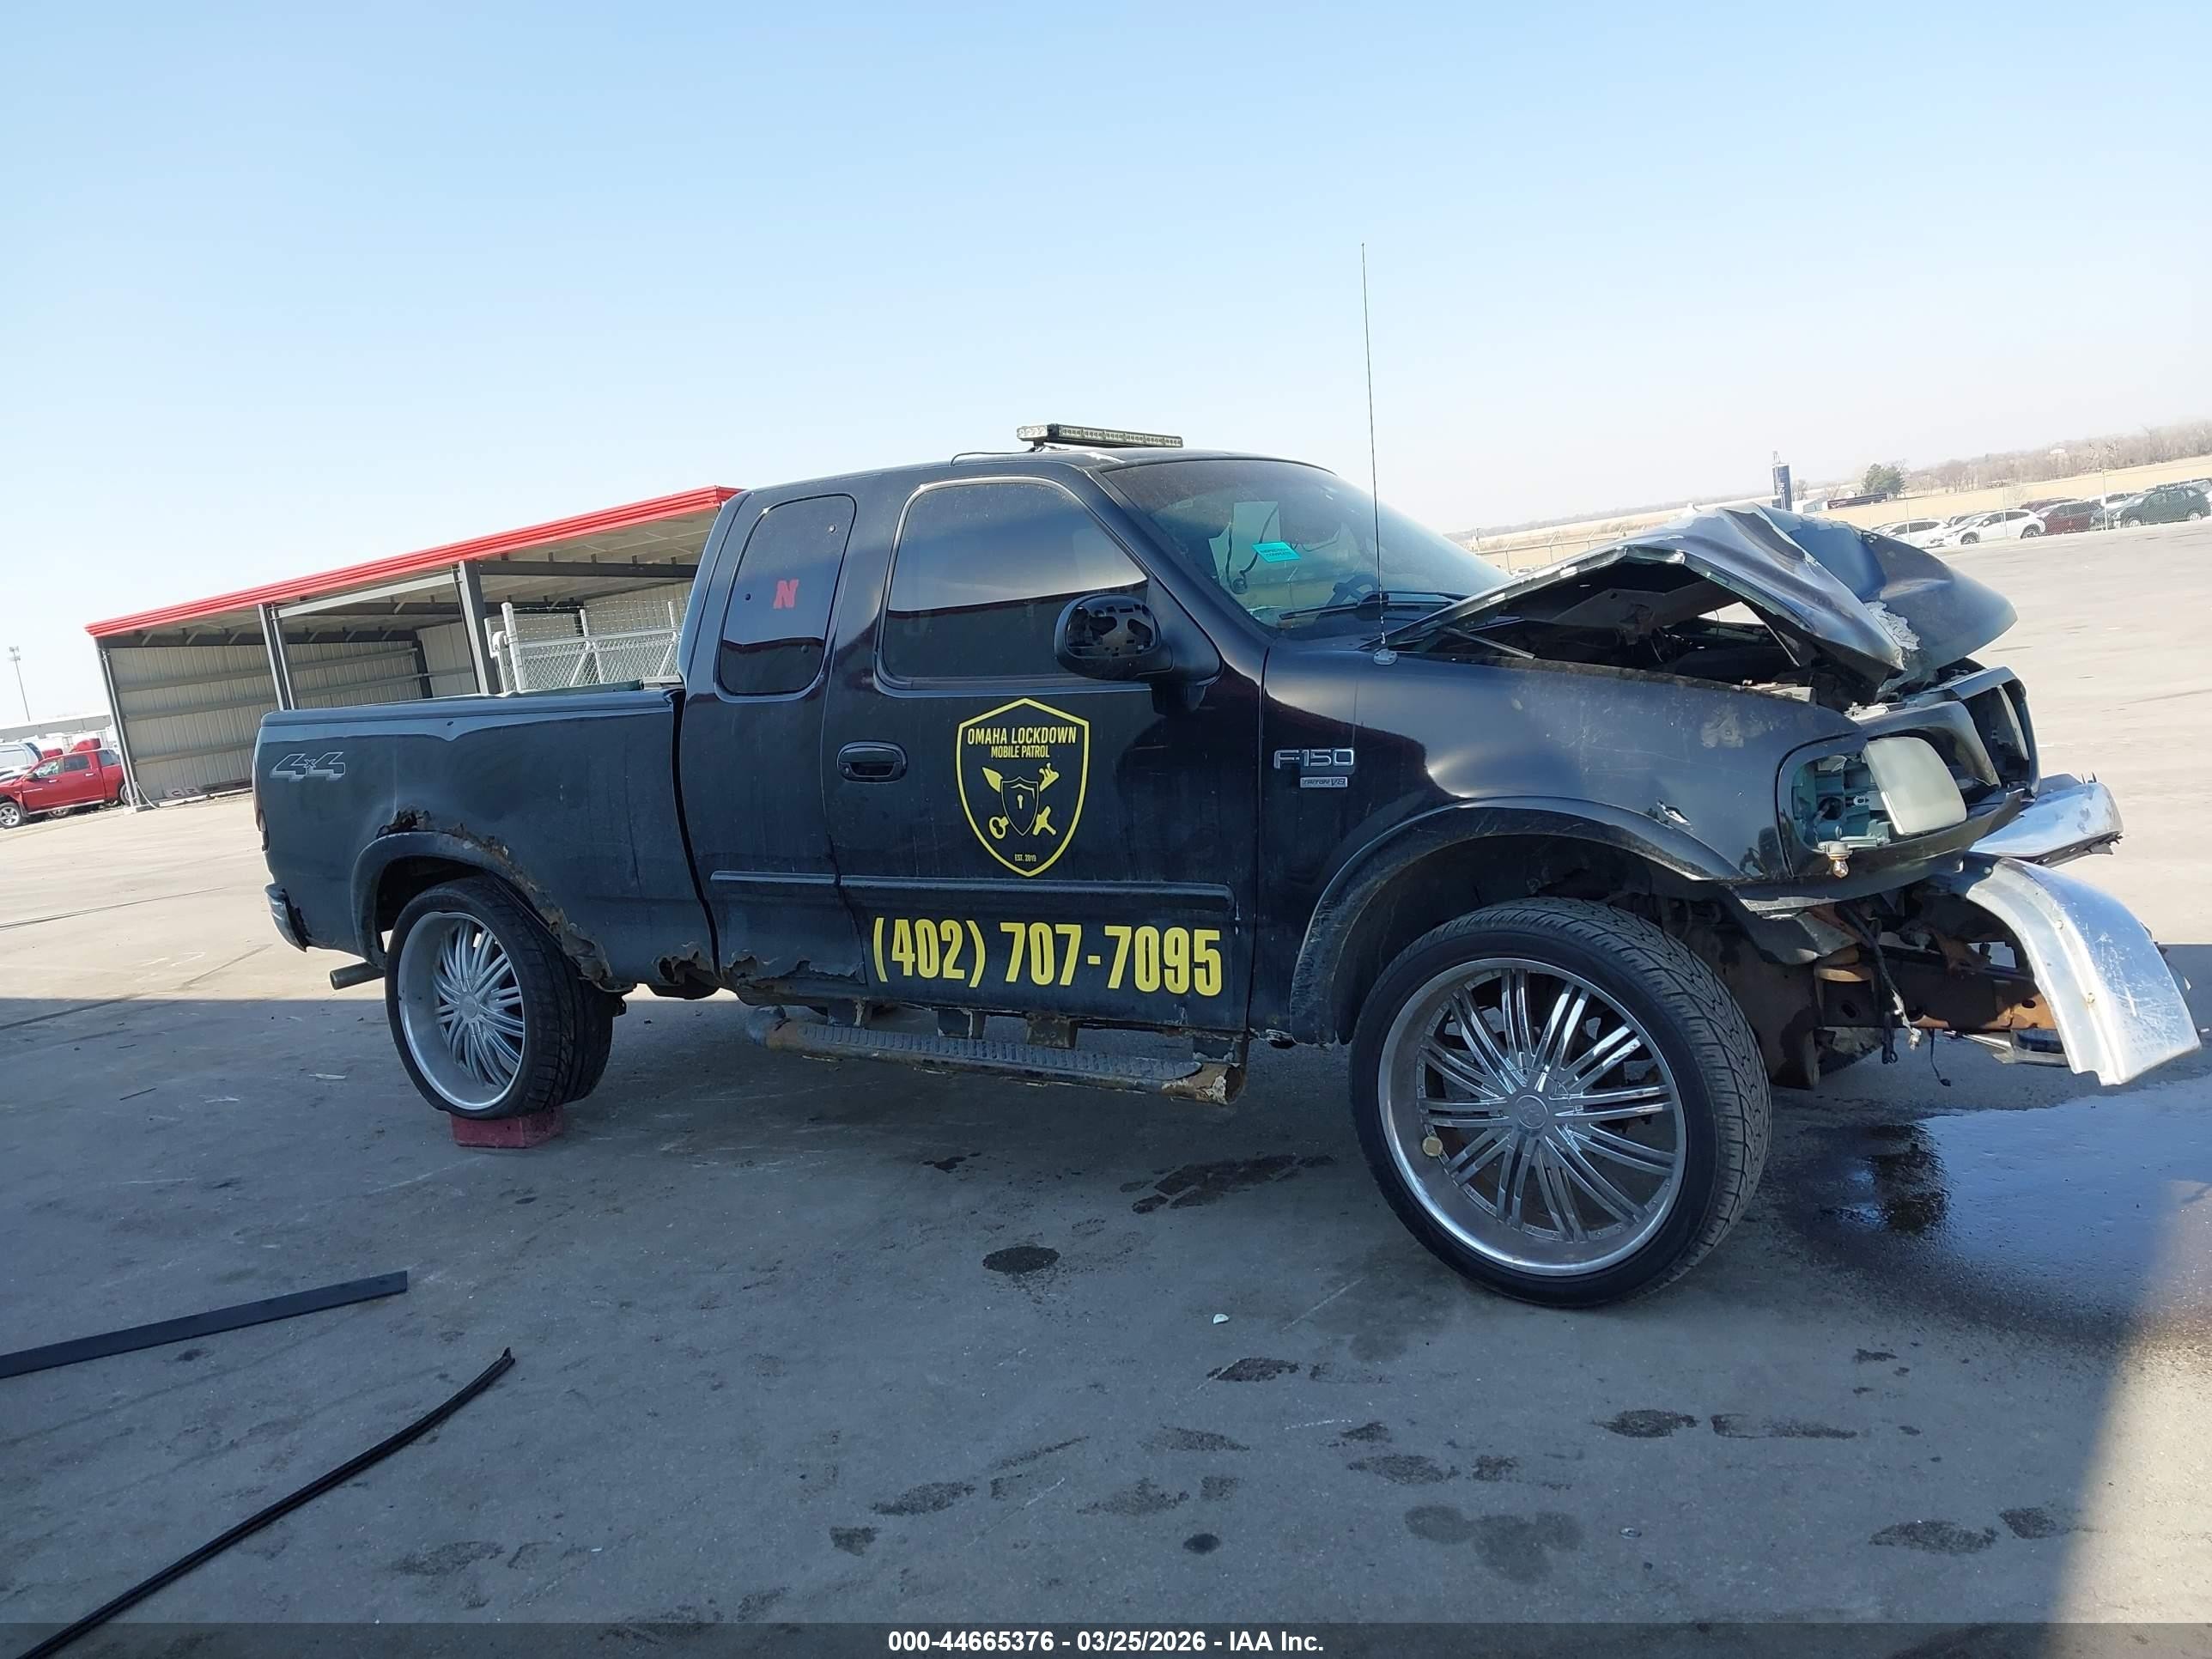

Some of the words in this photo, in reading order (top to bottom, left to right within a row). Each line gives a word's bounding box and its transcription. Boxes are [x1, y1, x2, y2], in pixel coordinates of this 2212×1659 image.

[773, 578, 799, 610] N
[966, 727, 1008, 745] OMAHA
[1011, 726, 1078, 744] LOCKDOWN
[990, 745, 1020, 758] MOBILE
[1021, 744, 1050, 758] PATROL
[872, 916, 987, 988] (402)
[1000, 921, 1223, 997] 707-7095
